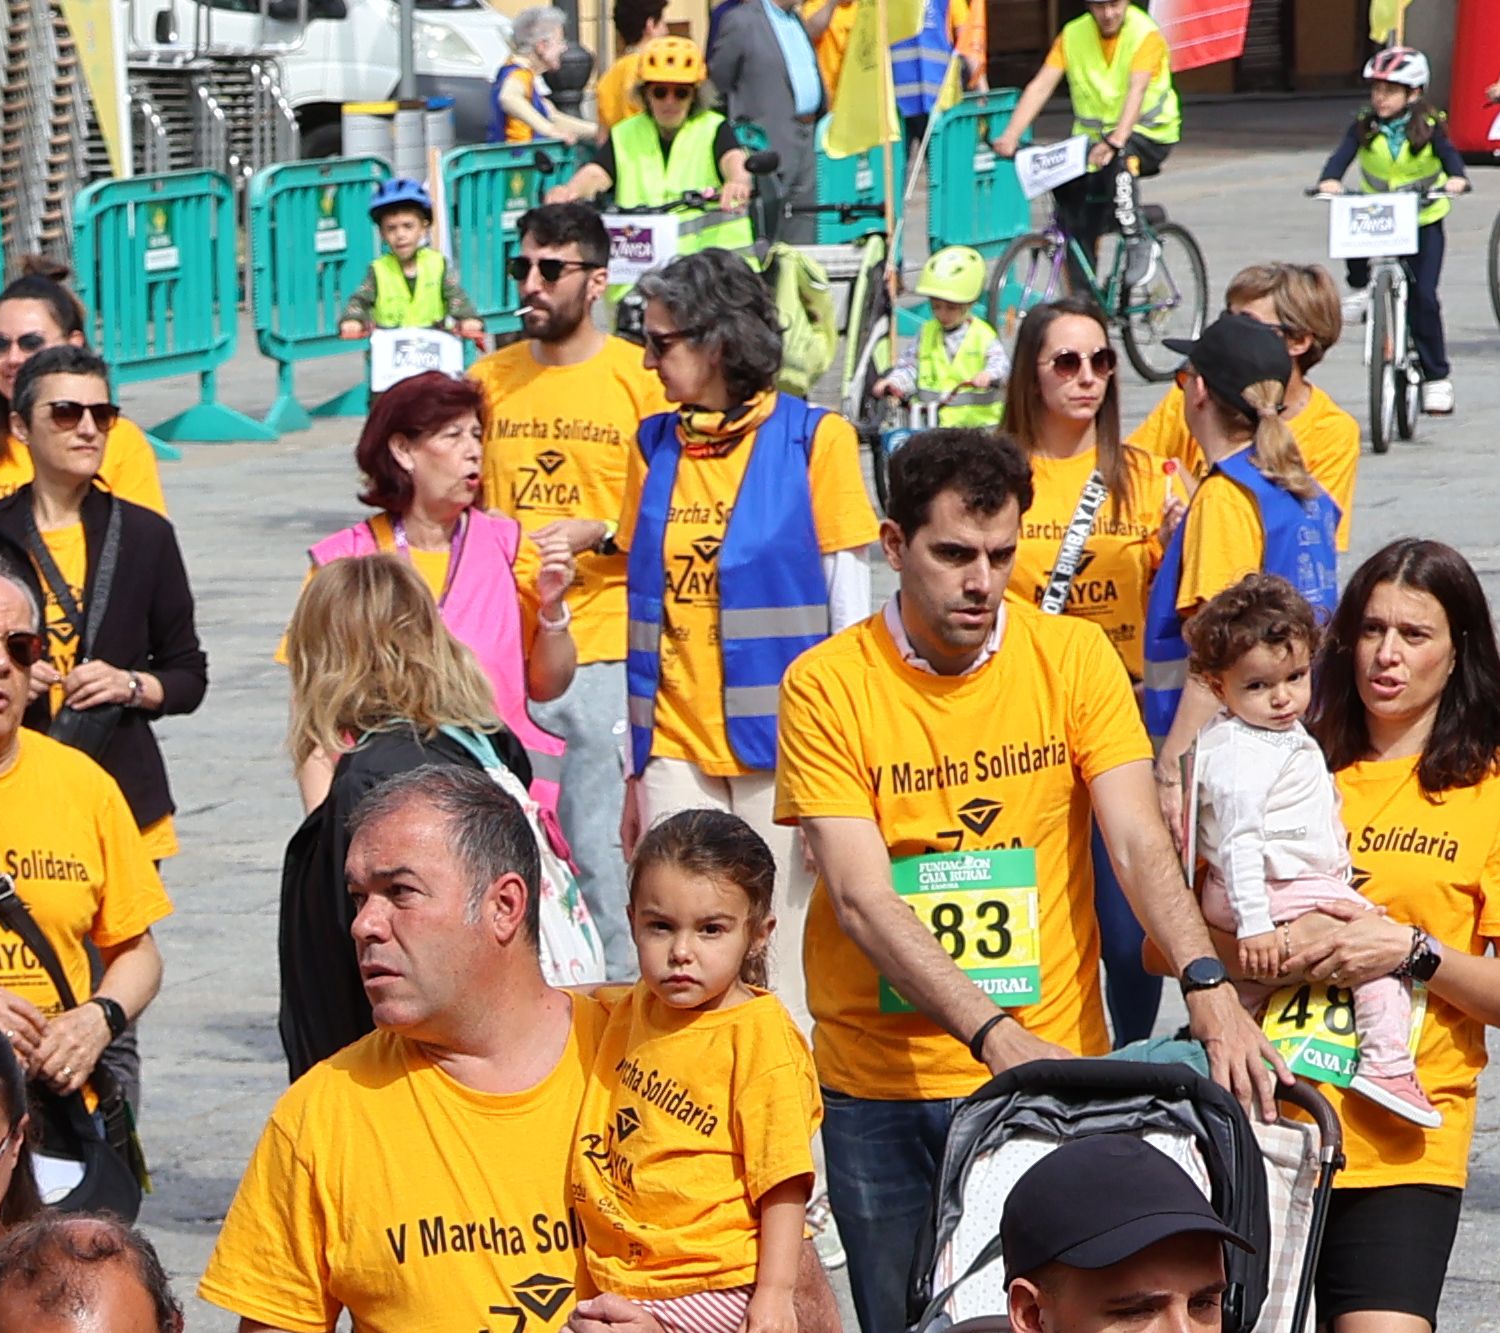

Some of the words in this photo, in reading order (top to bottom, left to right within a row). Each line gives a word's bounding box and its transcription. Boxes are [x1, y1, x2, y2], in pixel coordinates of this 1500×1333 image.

[497, 418, 549, 441] Marcha
[553, 418, 621, 446] Solidaria
[891, 755, 969, 795] Marcha
[973, 736, 1067, 784] Solidaria
[6, 848, 90, 883] Solidaria
[1356, 825, 1459, 863] Solidaria
[912, 899, 1013, 960] 83
[641, 1069, 720, 1138] Solidaria
[387, 1227, 407, 1266] V
[419, 1217, 528, 1257] Marcha
